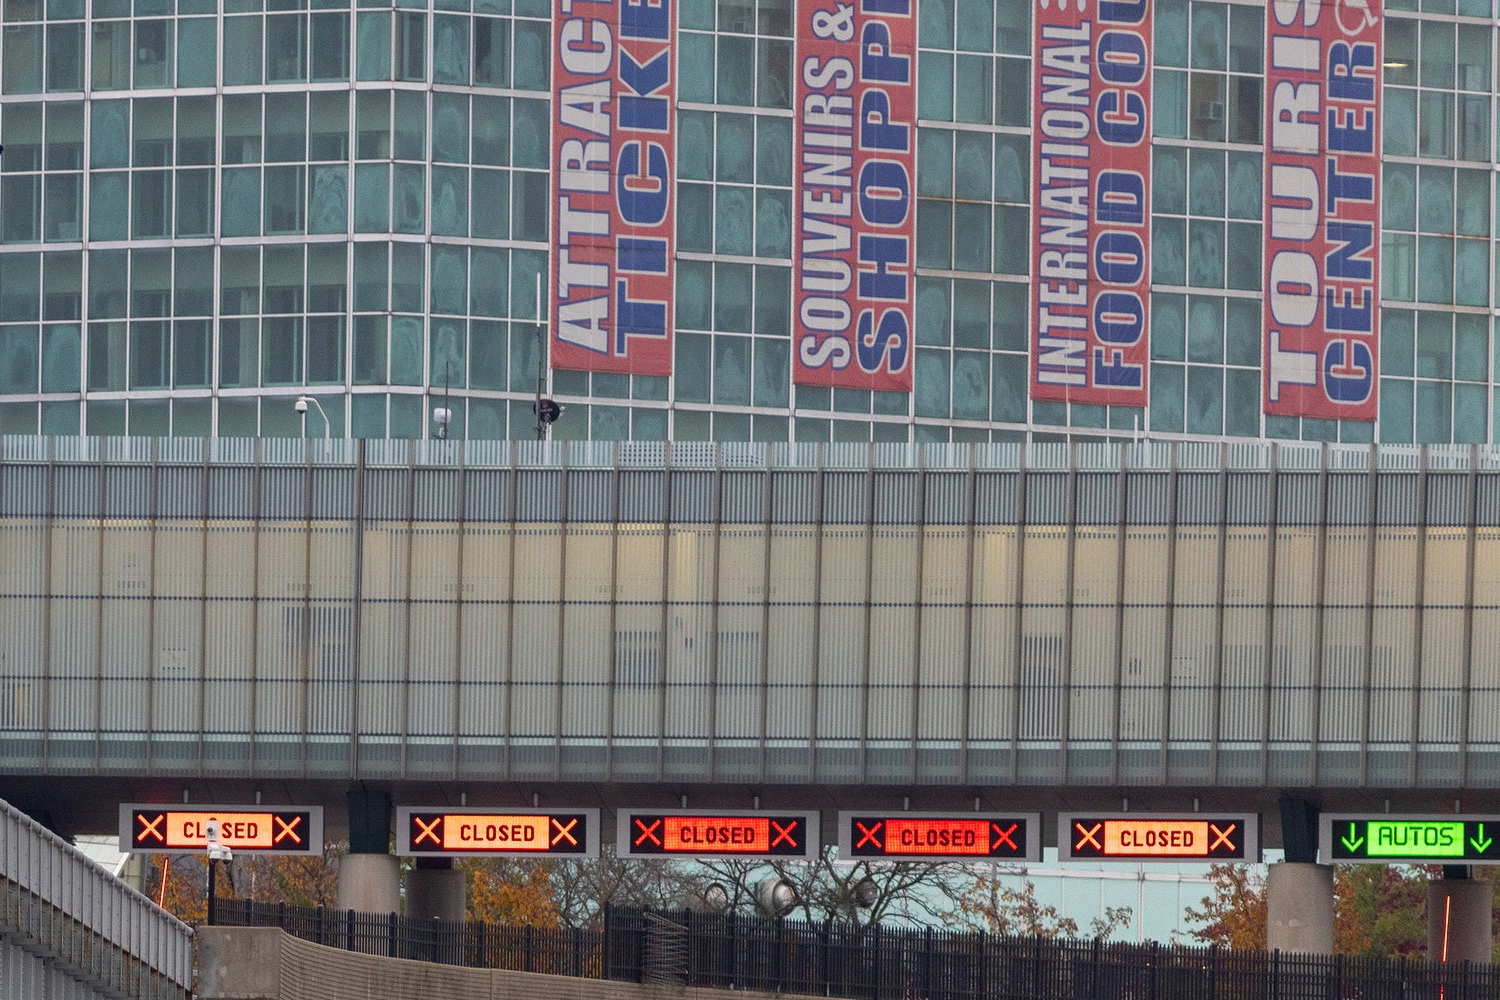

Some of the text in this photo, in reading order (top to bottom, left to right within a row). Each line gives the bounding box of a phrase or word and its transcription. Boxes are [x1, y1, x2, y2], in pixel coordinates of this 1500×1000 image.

[800, 2, 855, 370] SOUVENIRS &
[1037, 20, 1092, 387] INTERNATIONAL
[1323, 39, 1376, 405] CENTER
[1092, 170, 1146, 391] FOOD
[183, 821, 258, 839] CLSED
[460, 824, 535, 842] CLOSED
[680, 826, 755, 844] CLOSED
[901, 829, 975, 847] CLOSED
[1121, 830, 1194, 847] CLOSED
[1378, 826, 1454, 846] AUTOS
